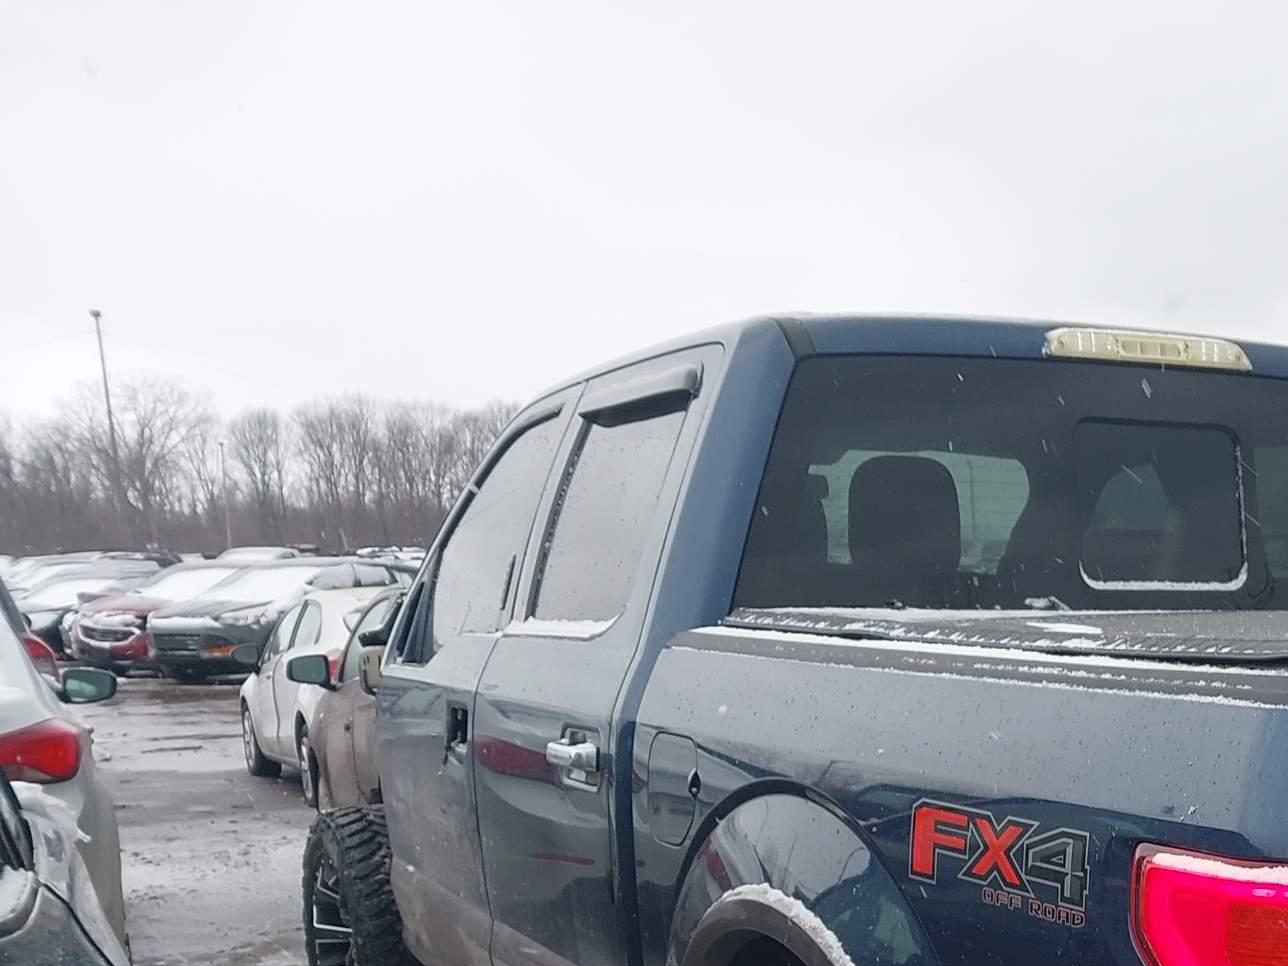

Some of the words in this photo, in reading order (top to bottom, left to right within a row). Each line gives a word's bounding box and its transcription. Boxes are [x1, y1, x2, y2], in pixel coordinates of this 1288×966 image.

[909, 798, 1090, 911] FX4
[982, 886, 1021, 910] OFF
[1028, 900, 1086, 927] ROAD
